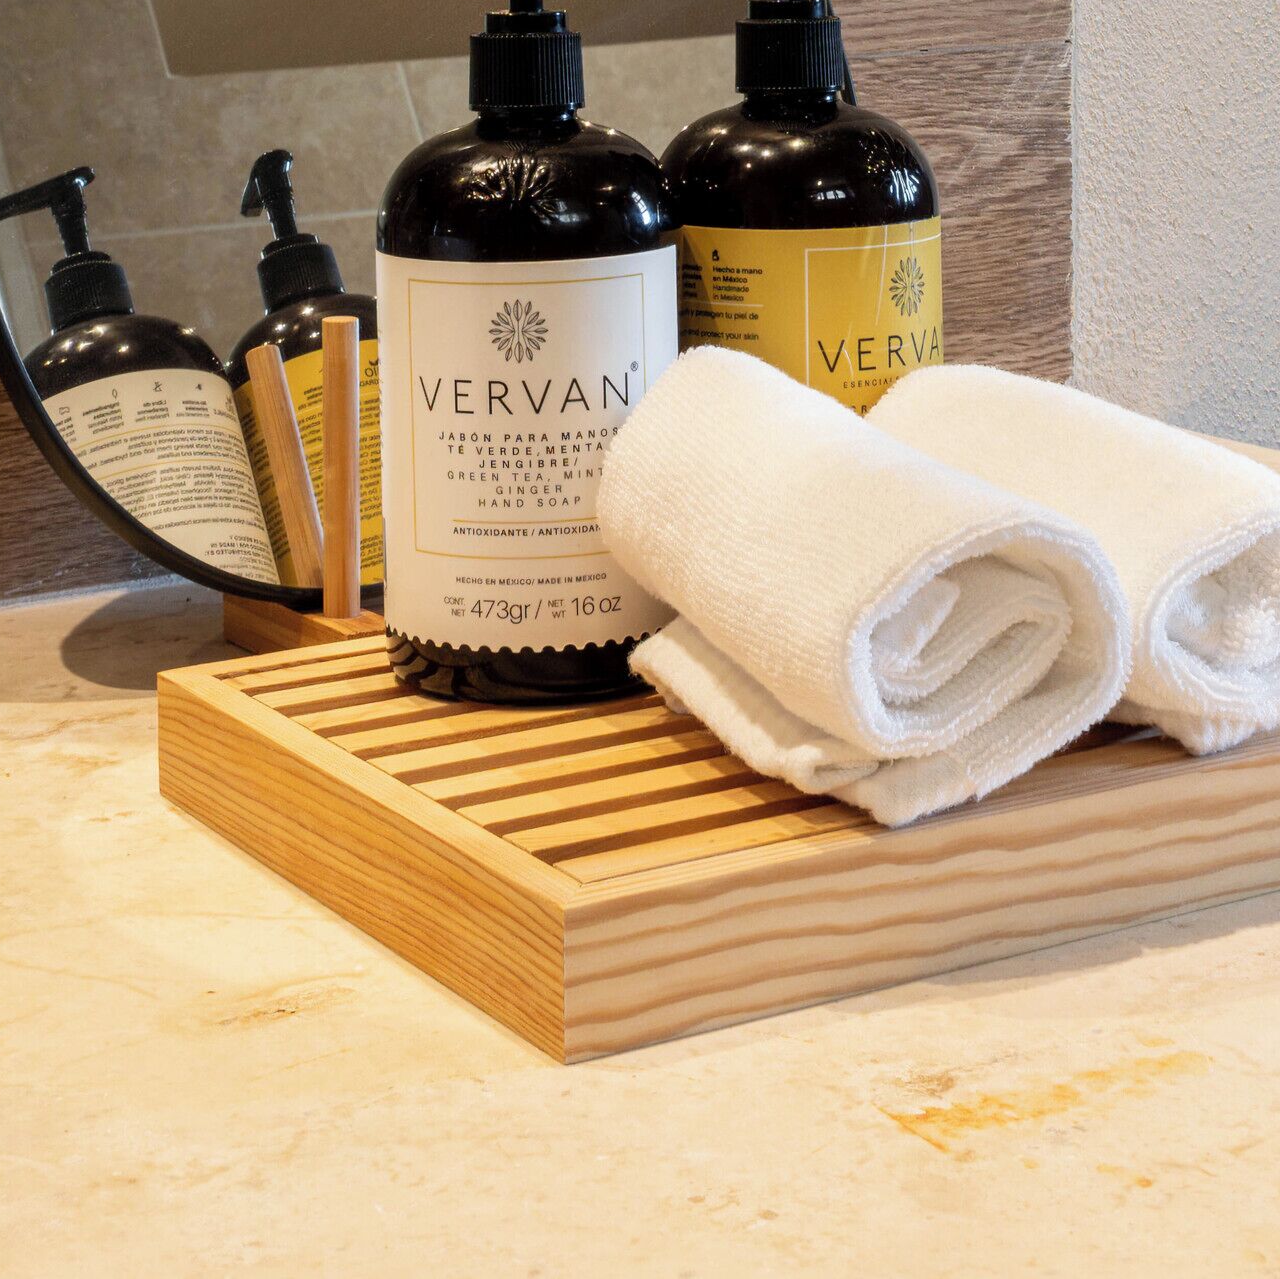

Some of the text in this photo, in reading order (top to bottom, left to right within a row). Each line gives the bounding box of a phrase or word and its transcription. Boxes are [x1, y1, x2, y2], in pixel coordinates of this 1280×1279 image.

[438, 426, 619, 443] JABÓN PARA MANOS
[447, 444, 465, 455] TÉ
[447, 470, 500, 482] GREEN
[512, 472, 551, 483] TEA,
[495, 484, 563, 495] GINGER
[478, 495, 581, 508] HAND SOAP
[453, 526, 528, 537] ANTIOXIDANTE
[537, 577, 562, 585] MADE
[564, 576, 573, 584] IN
[547, 598, 564, 609] NET
[571, 595, 595, 616] 16
[450, 608, 467, 618] NET
[470, 599, 531, 625] 473gr
[551, 610, 567, 619] WT
